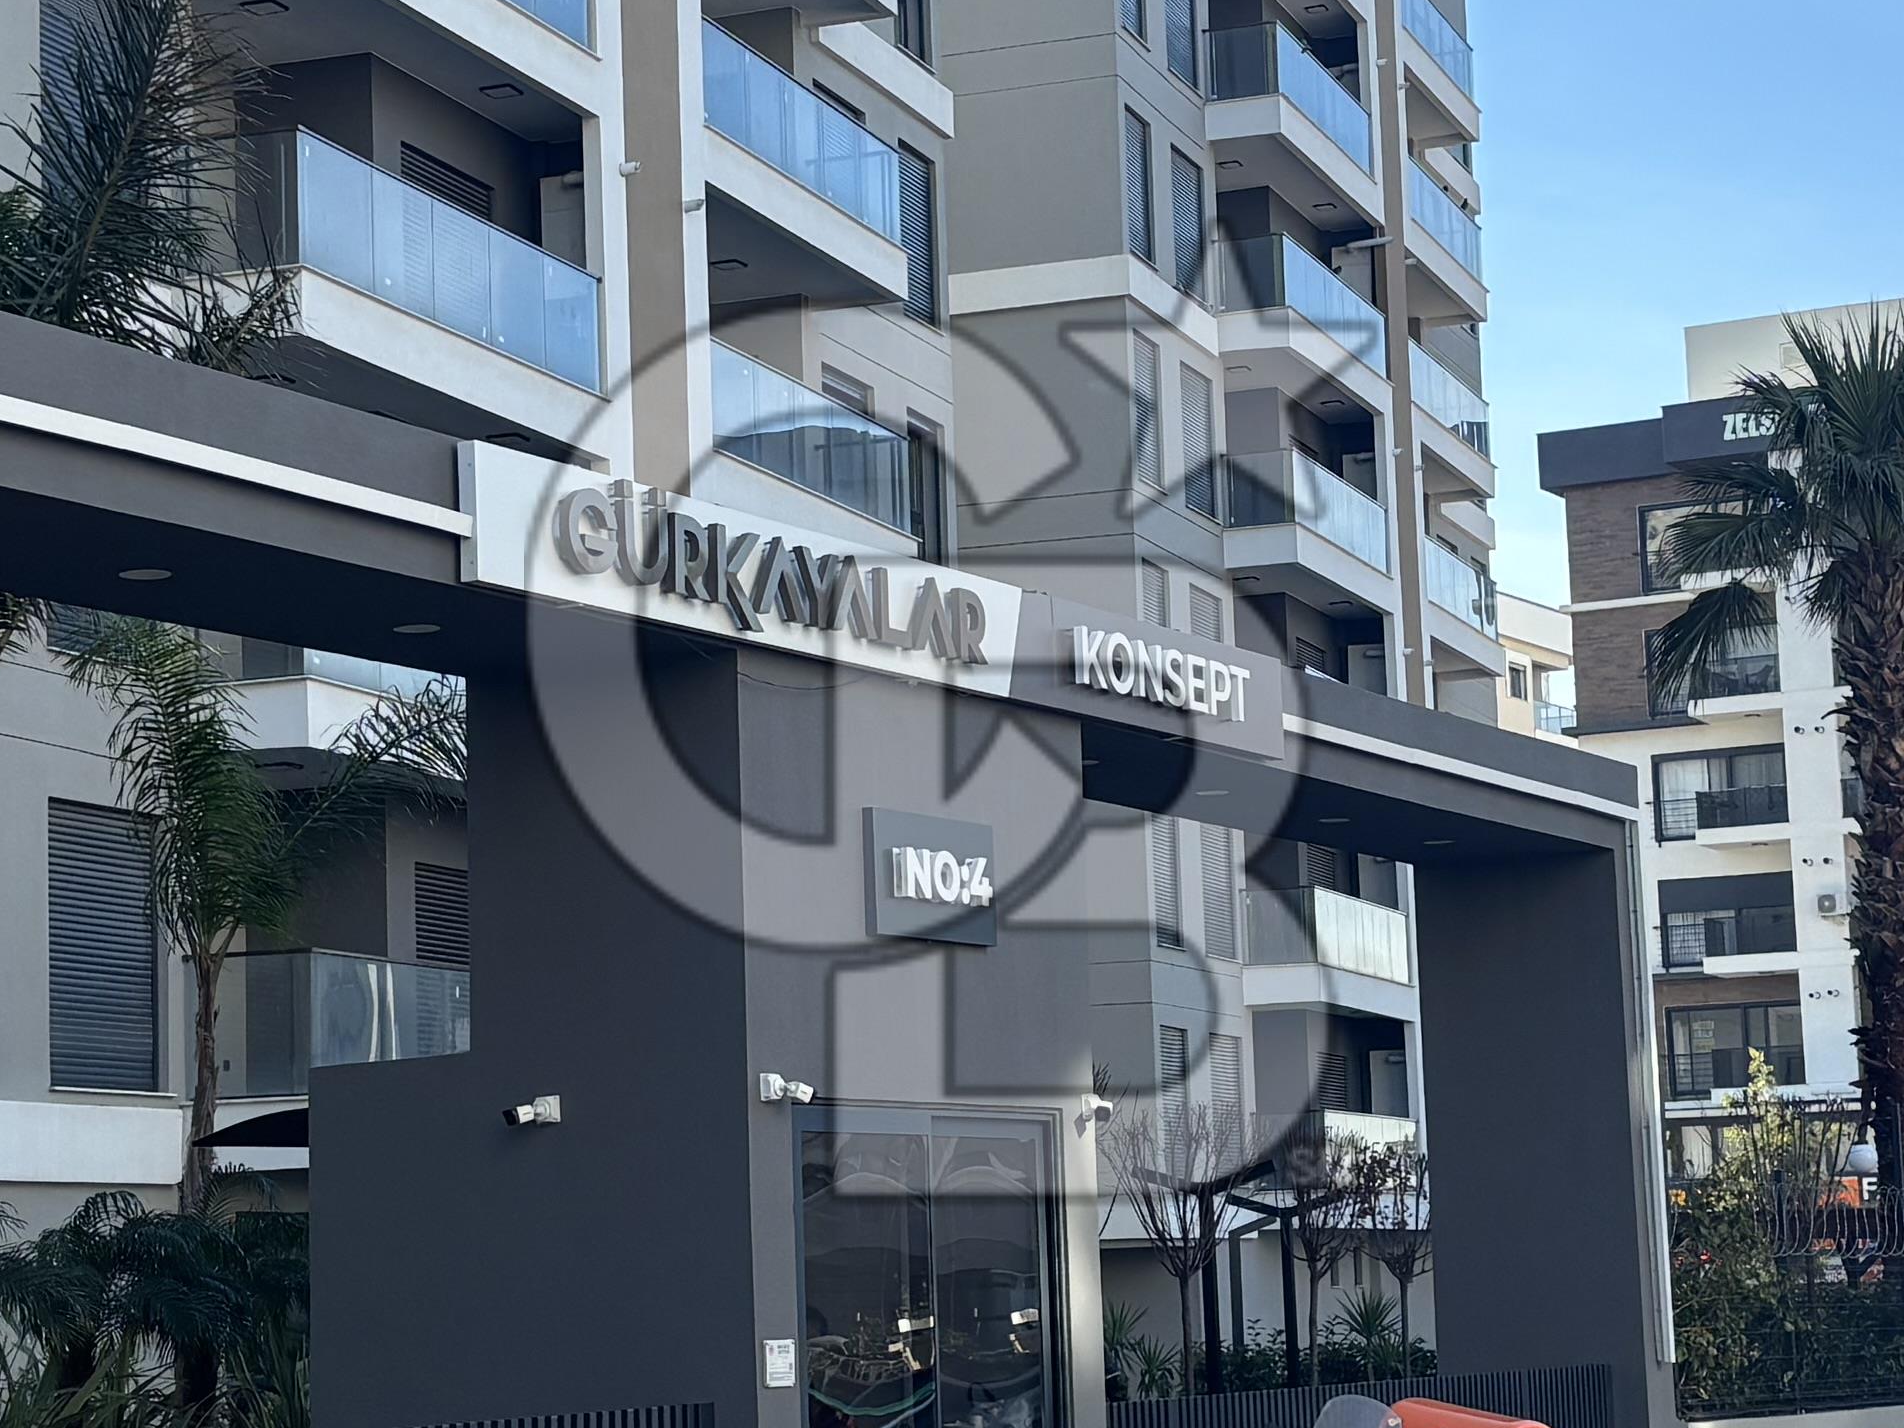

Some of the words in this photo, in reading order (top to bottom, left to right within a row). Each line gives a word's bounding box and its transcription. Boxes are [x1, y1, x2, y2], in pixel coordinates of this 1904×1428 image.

[1722, 409, 1781, 441] ZELS
[553, 478, 988, 665] GÜRKAYALAR
[1073, 625, 1251, 722] KONSEPT
[892, 846, 993, 907] NO:4
